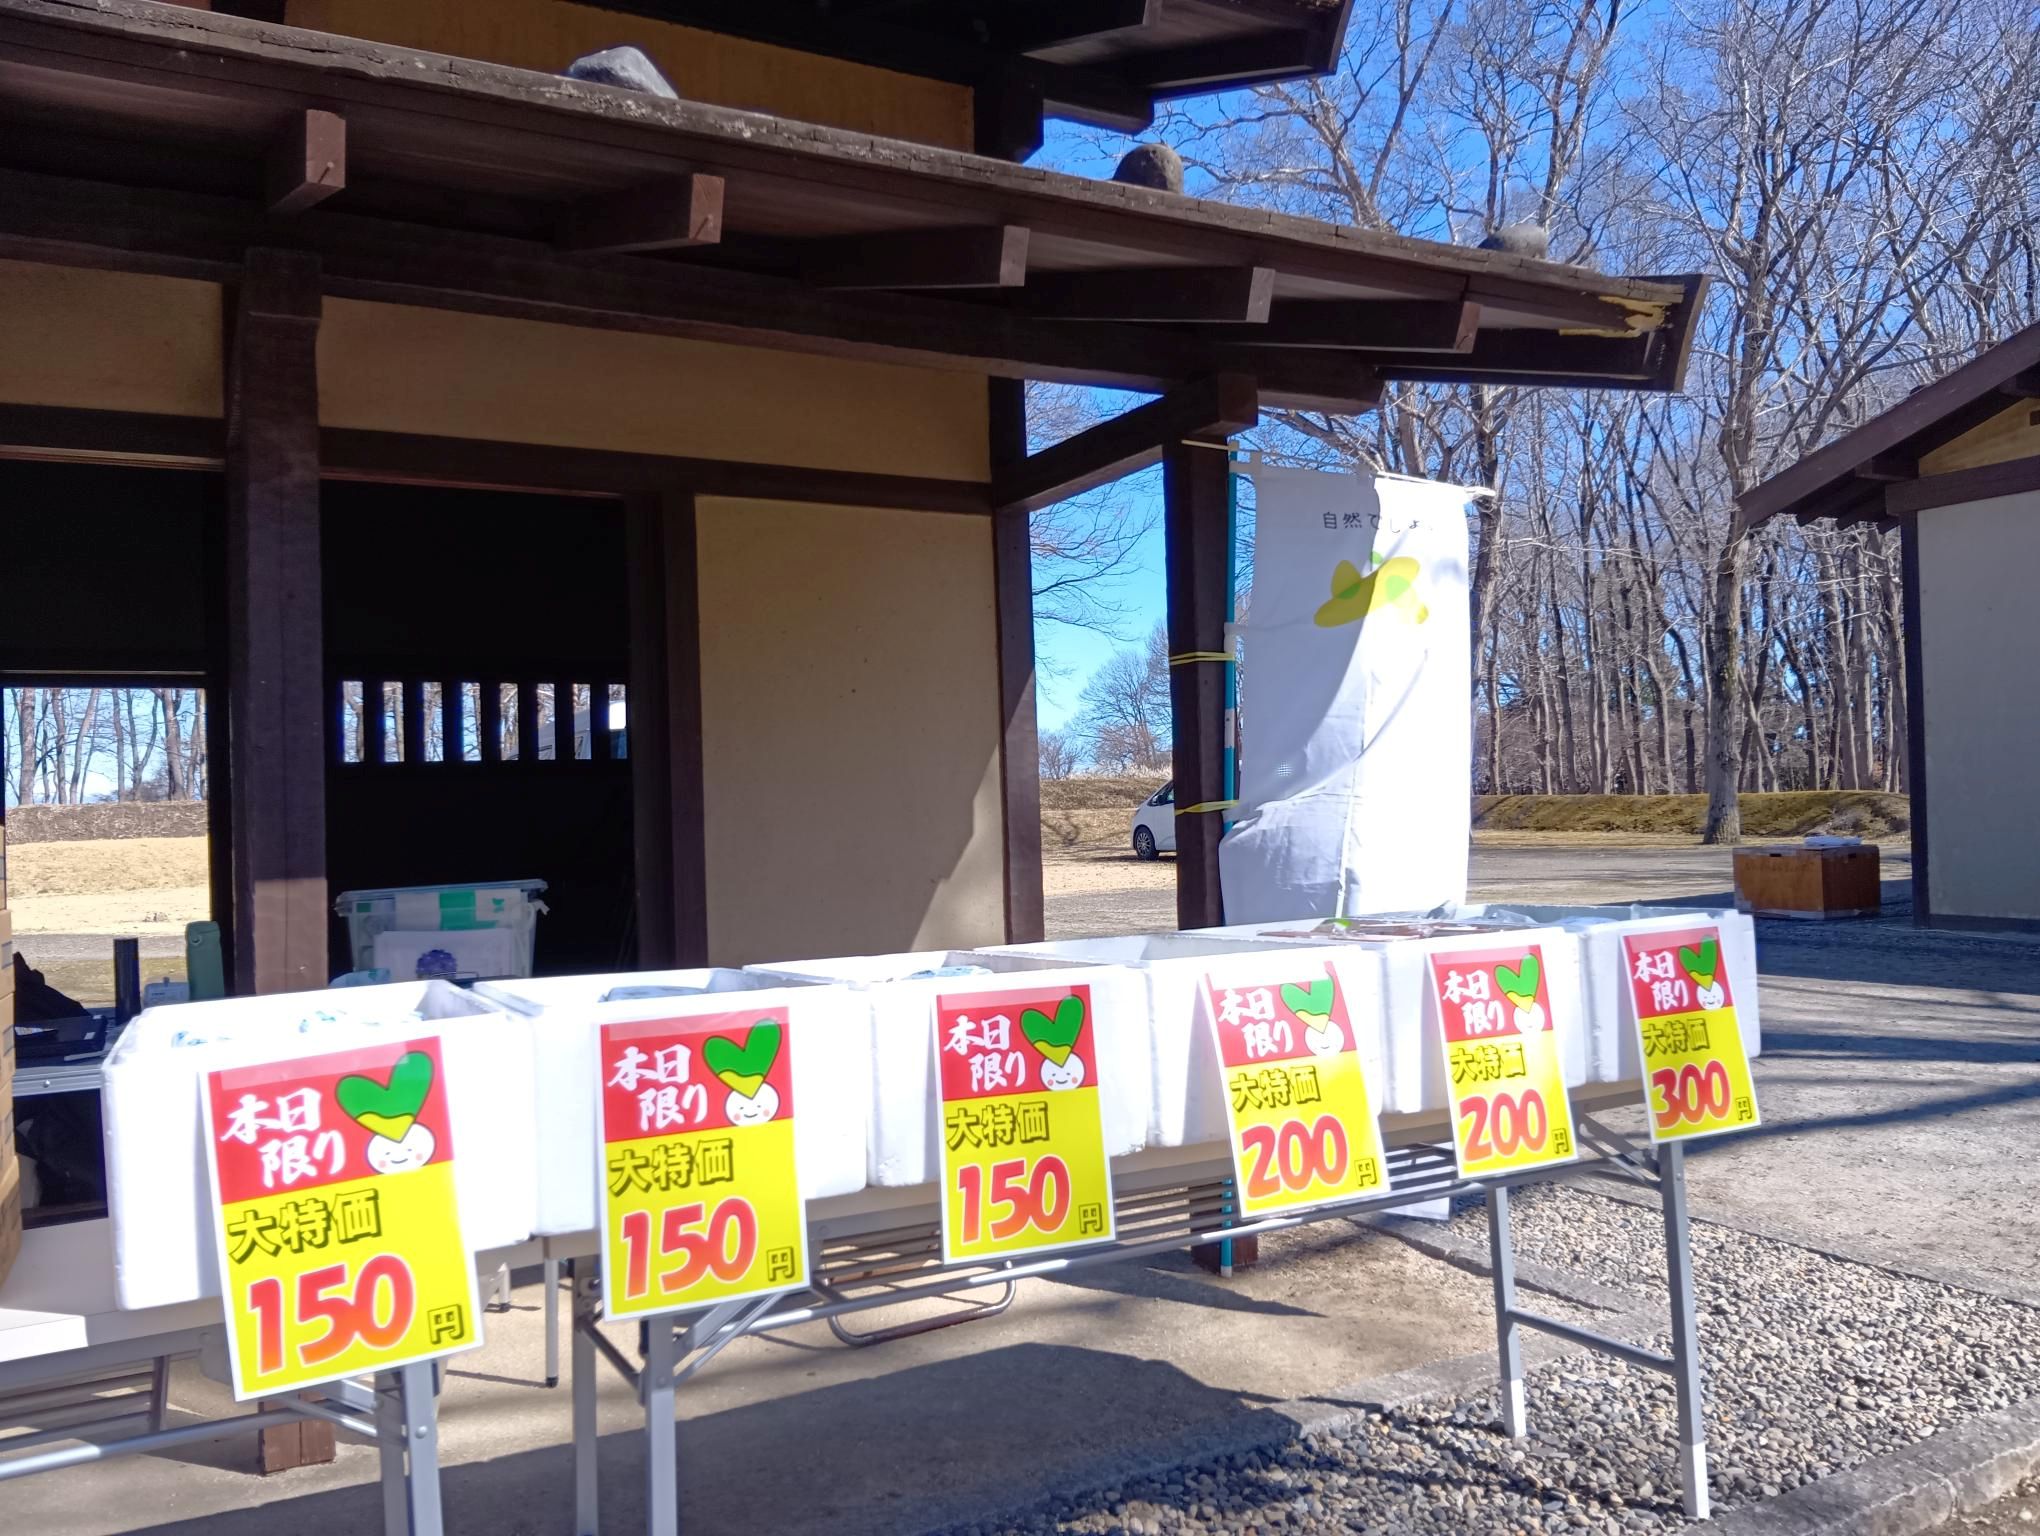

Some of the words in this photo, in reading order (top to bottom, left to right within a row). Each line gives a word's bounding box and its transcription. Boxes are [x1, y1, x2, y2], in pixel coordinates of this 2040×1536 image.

[1323, 511, 1434, 534] 自然でしょ
[1442, 969, 1489, 1003] 本日
[1633, 951, 1675, 983] 本日
[1218, 988, 1275, 1026] 本日
[1651, 982, 1688, 1011] 限り
[944, 1014, 1011, 1056] 本日
[1243, 1020, 1293, 1058] 限り
[1461, 1002, 1504, 1035] 限り
[1642, 1019, 1709, 1057] 大特価
[607, 1043, 692, 1091] 本日
[969, 1053, 1026, 1092] 限り
[1451, 1043, 1526, 1084] 大特価
[638, 1083, 708, 1131] 限り
[1230, 1066, 1322, 1112] 大特価
[221, 1087, 321, 1144] 本日
[946, 1101, 1049, 1150] 大特価
[258, 1127, 345, 1189] 限り
[608, 1137, 733, 1196] 大特価
[227, 1187, 381, 1264] 大特価
